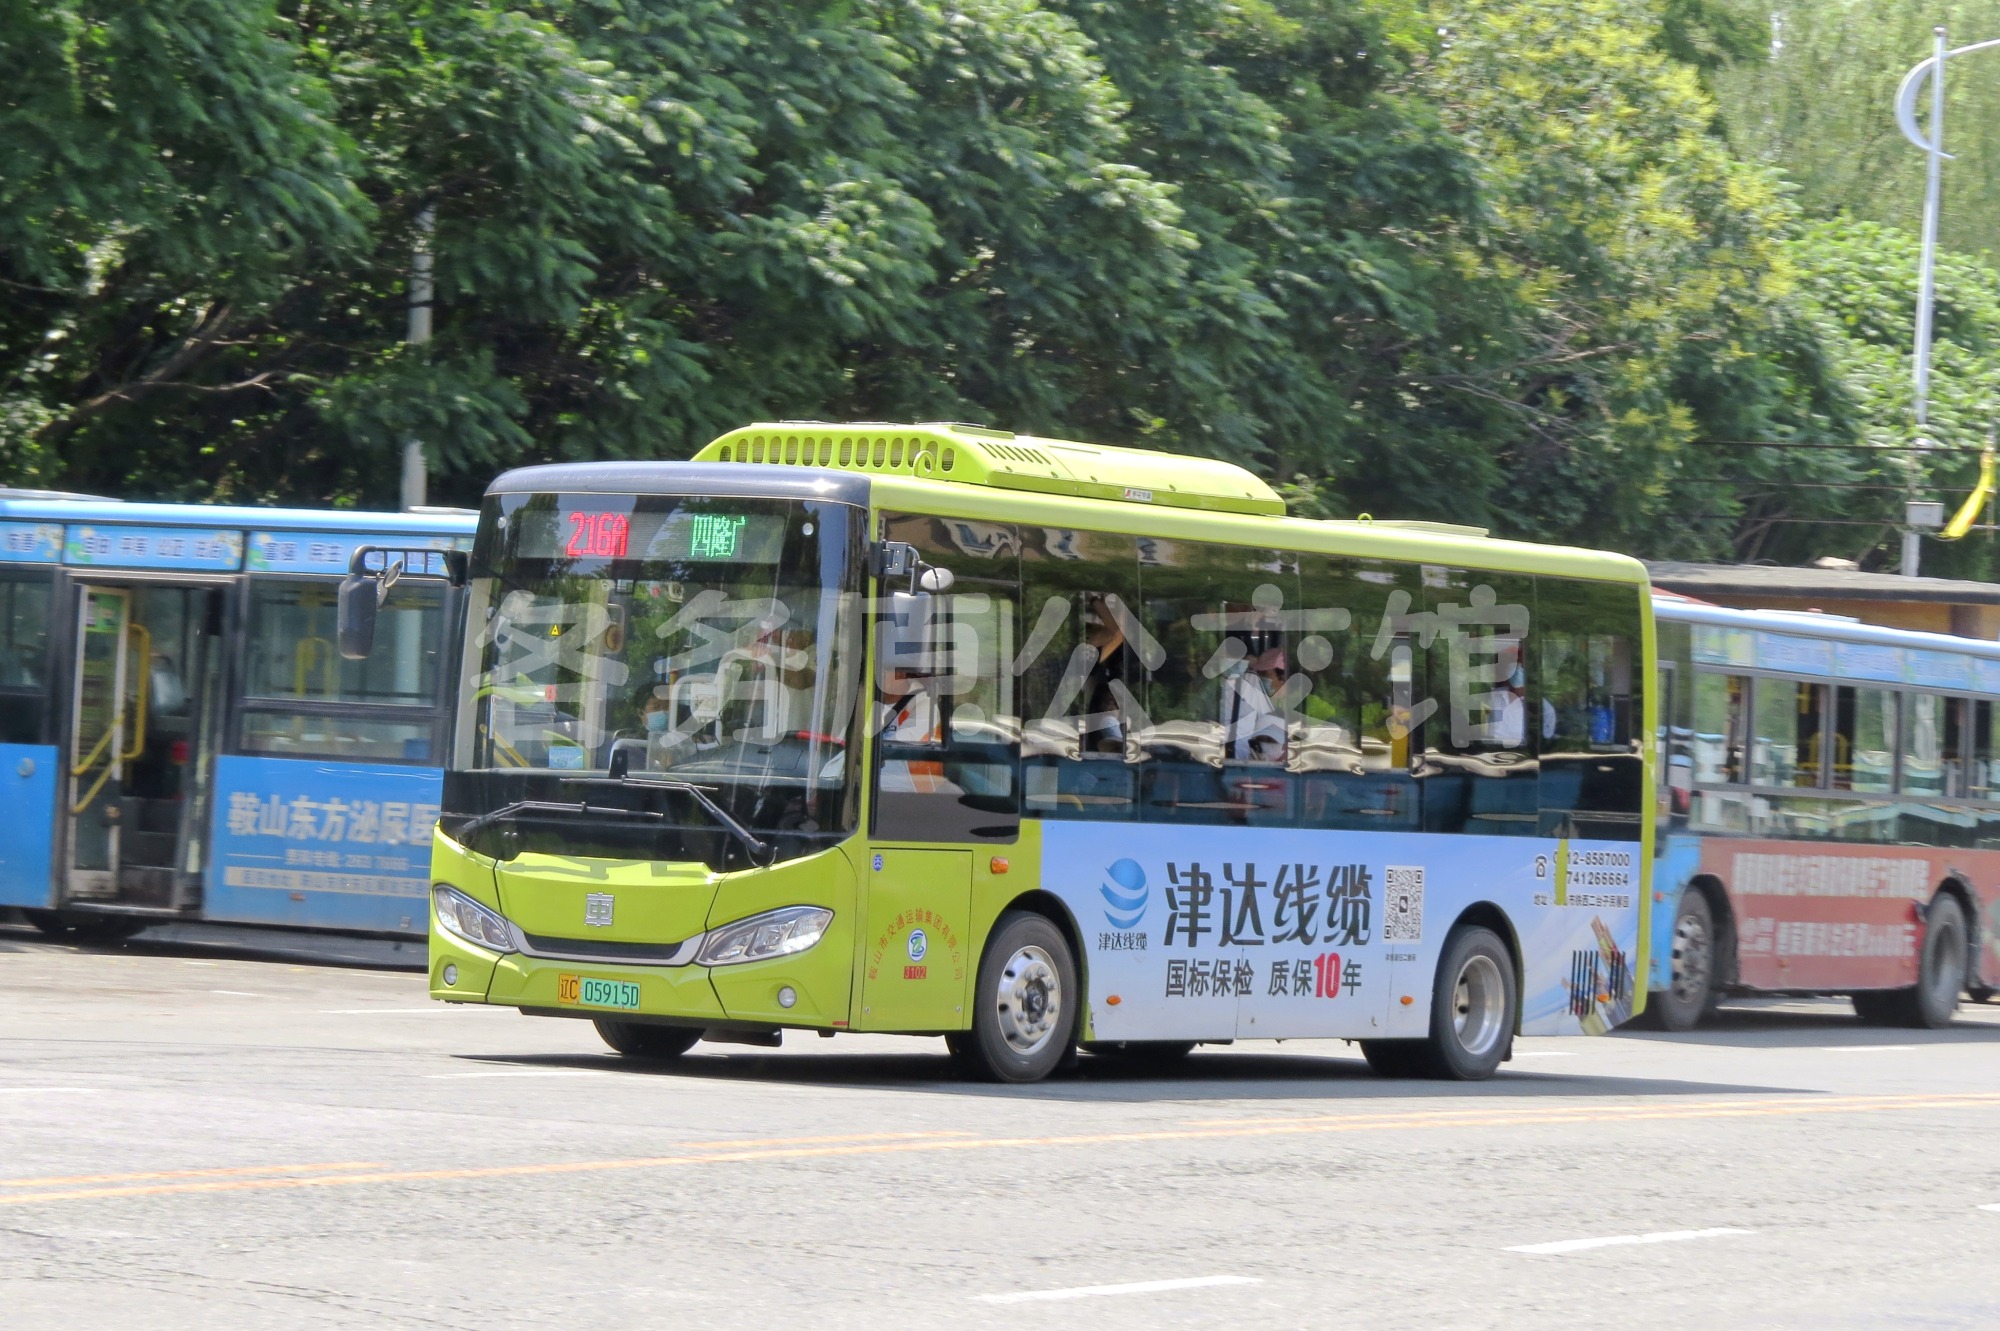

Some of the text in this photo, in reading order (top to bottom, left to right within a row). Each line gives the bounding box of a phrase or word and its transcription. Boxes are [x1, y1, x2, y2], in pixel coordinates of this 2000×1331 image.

[566, 511, 629, 557] 216A
[1553, 850, 1629, 867] 012-8587000
[1553, 870, 1629, 886] 741266664
[1163, 862, 1373, 948] 津达线缆
[867, 907, 964, 983] 鞍山市交通运输集团有限公司
[1099, 932, 1148, 951] 津达线缆
[904, 965, 927, 979] 3102
[1164, 952, 1363, 999] 国标保检 质保10年
[560, 978, 640, 1006] 辽C 05915D
